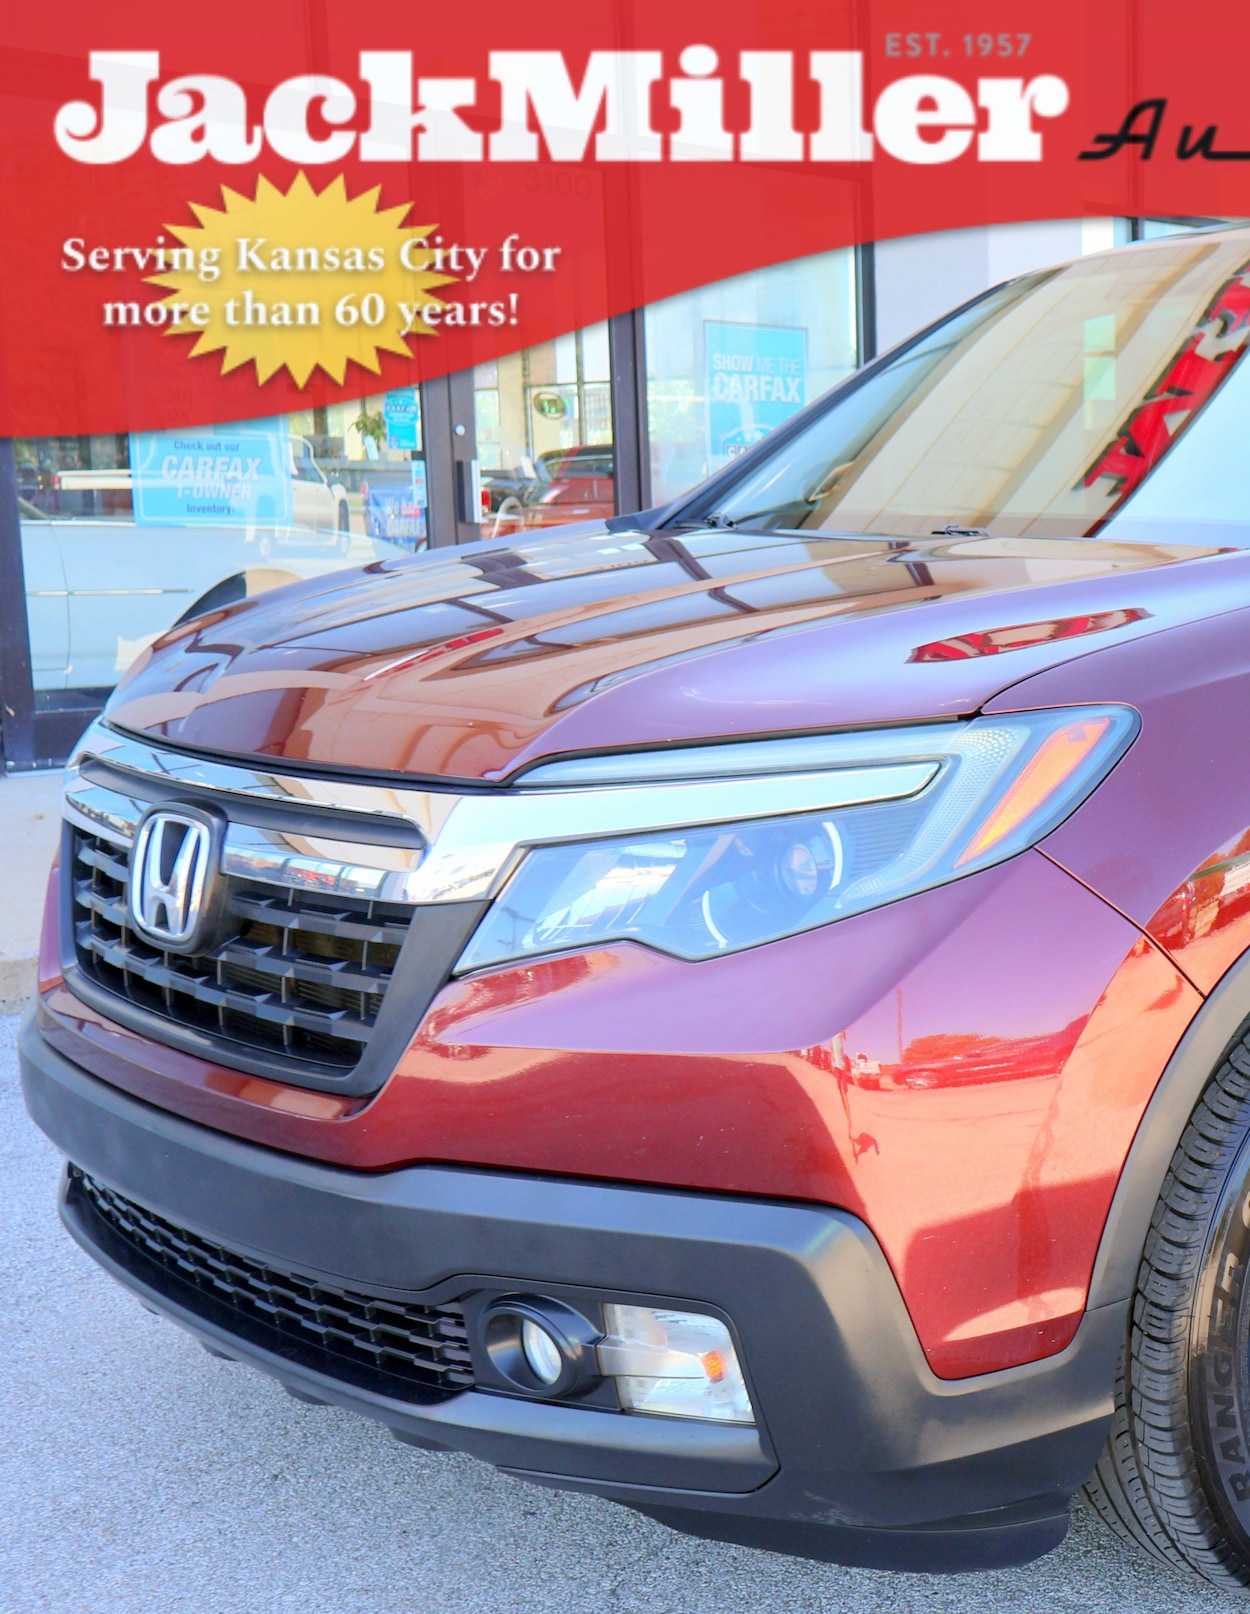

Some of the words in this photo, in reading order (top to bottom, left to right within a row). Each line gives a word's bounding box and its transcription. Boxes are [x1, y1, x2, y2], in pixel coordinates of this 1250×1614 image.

[713, 353, 754, 372] SHOW
[756, 356, 775, 374] ME
[780, 357, 800, 376] THE
[712, 371, 803, 404] CARFAX
[174, 440, 203, 451] Check
[206, 441, 221, 451] out
[225, 443, 240, 452] our
[160, 454, 262, 481] CARFAX
[176, 482, 253, 499] 1-OWNER
